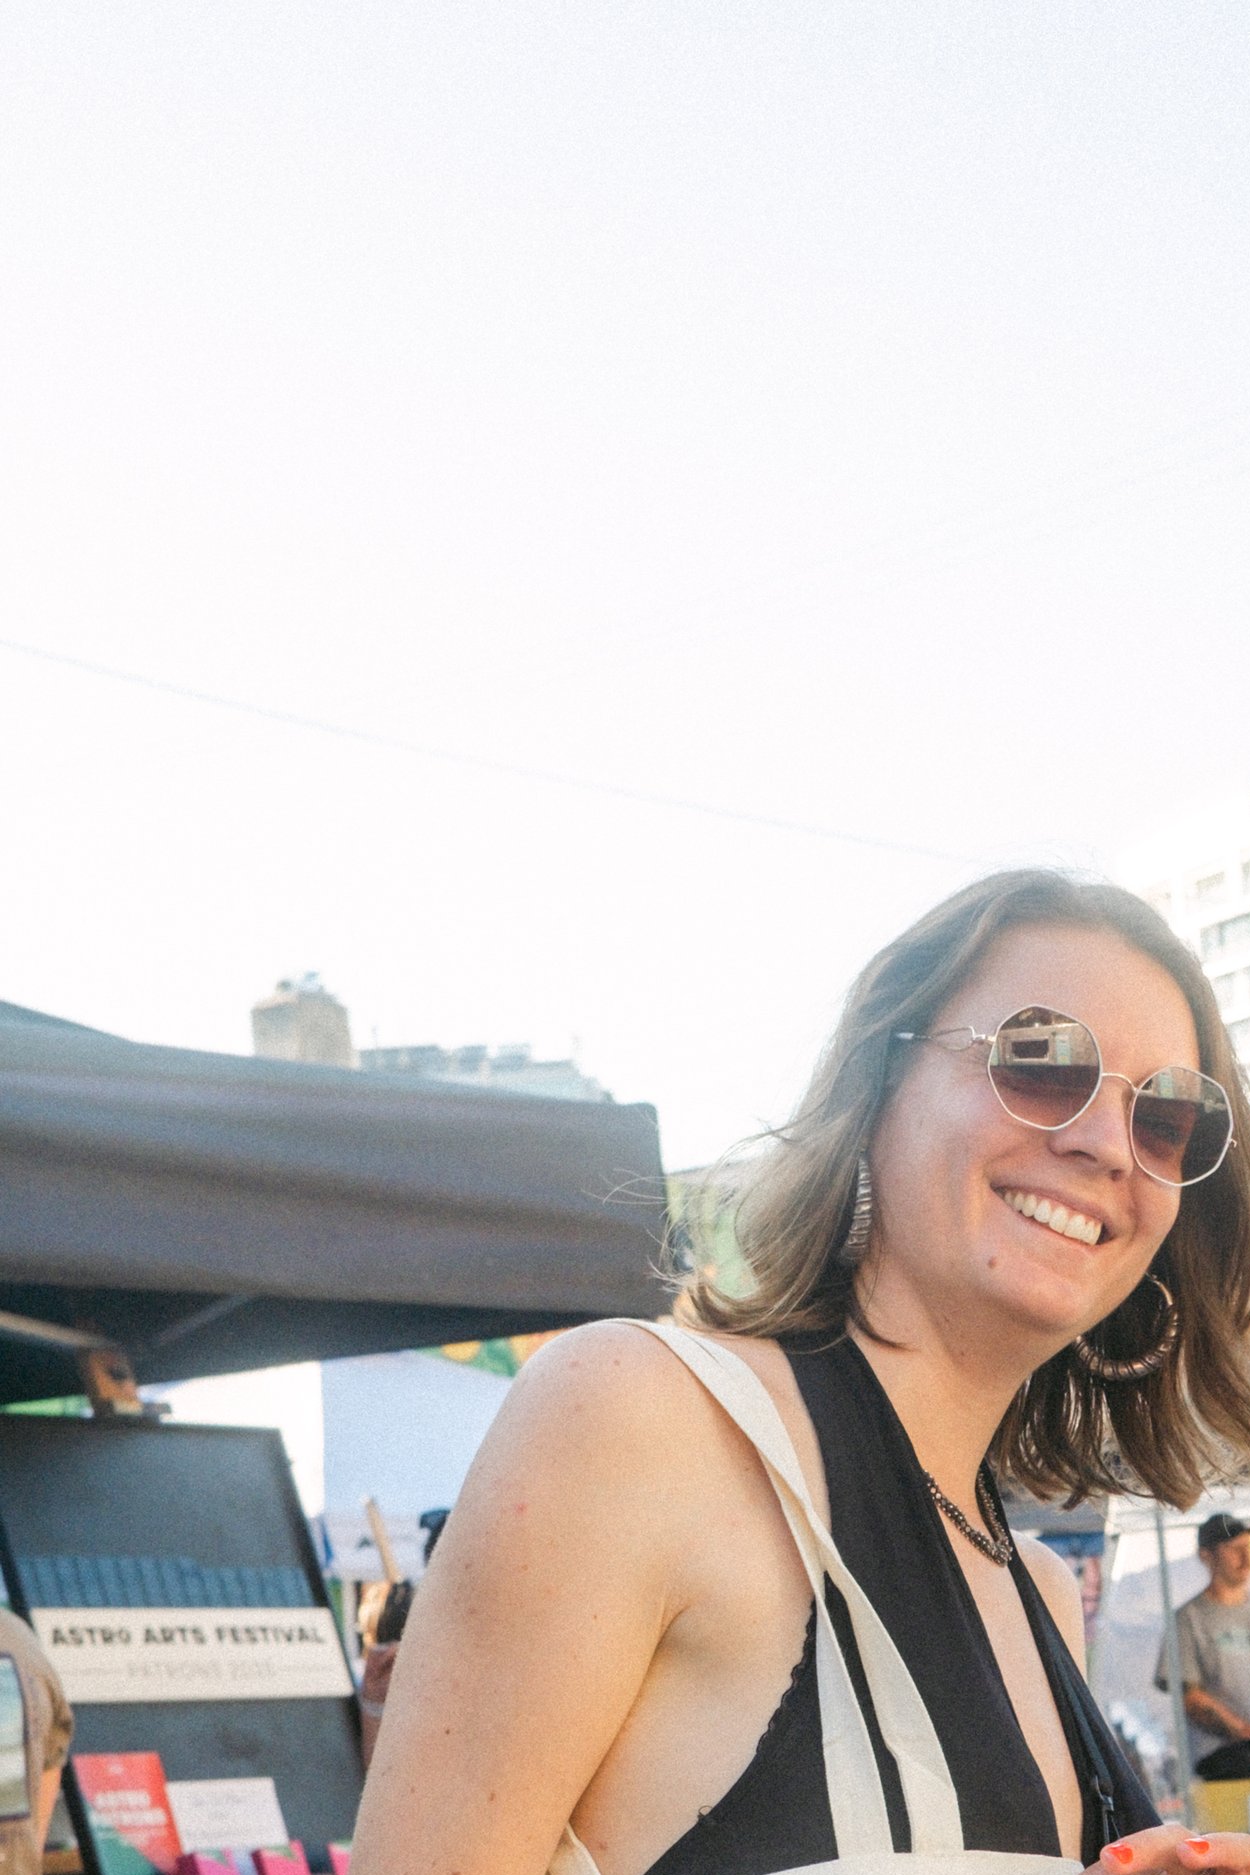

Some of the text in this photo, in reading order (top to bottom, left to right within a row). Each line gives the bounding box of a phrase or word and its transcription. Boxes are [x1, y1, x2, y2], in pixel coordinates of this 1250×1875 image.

[52, 1625, 325, 1646] ASTRO ARTS FESTIVAL
